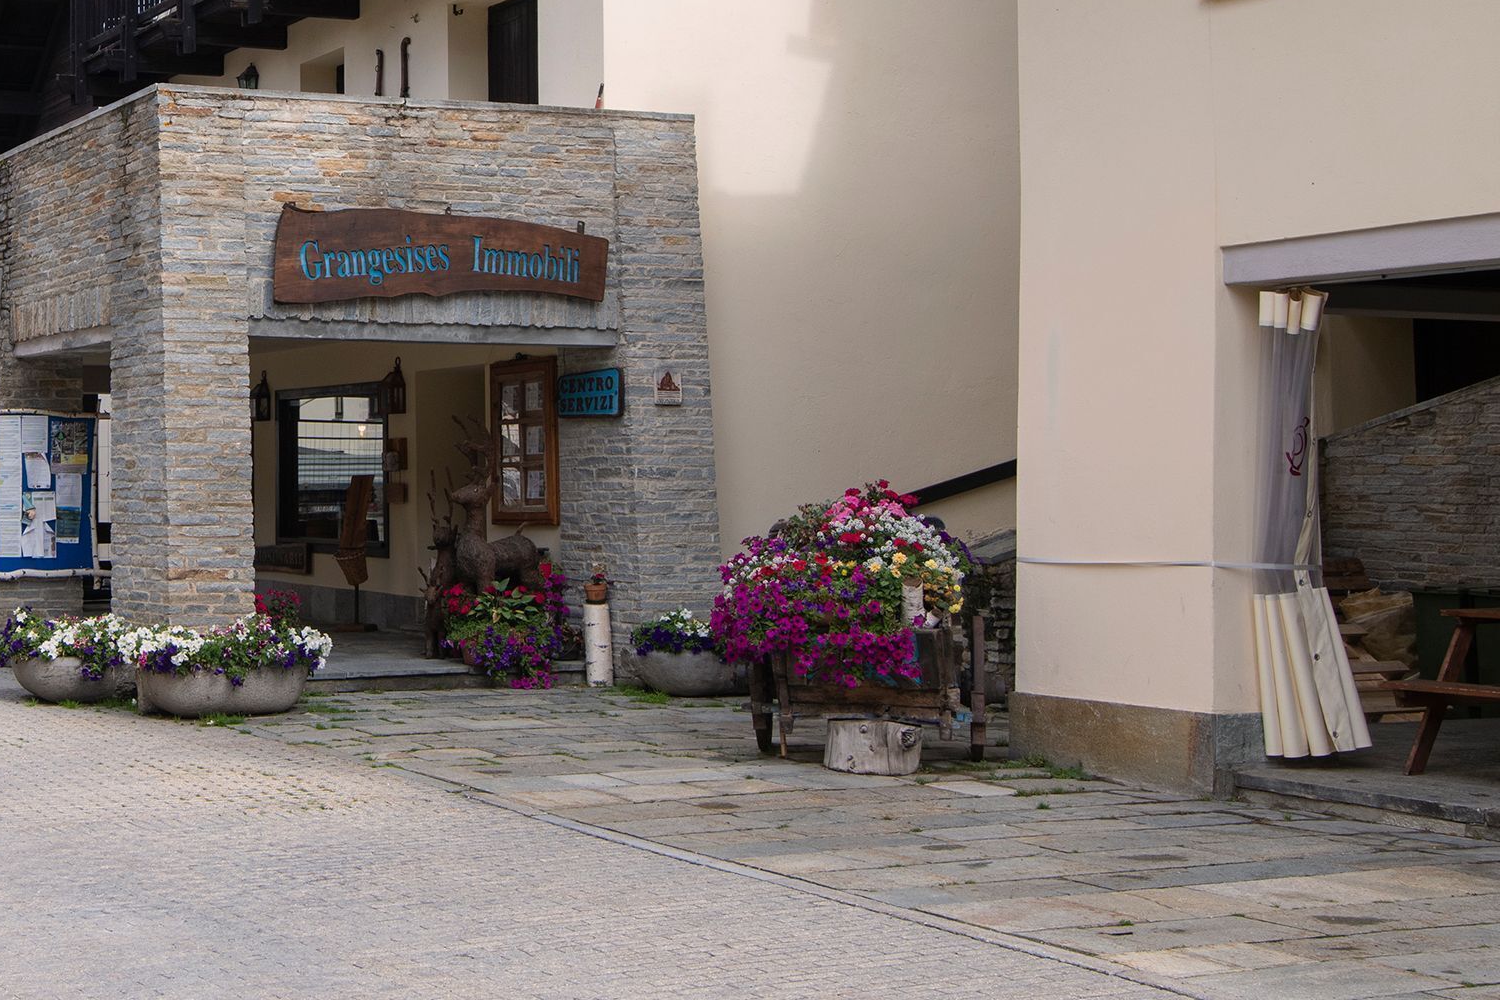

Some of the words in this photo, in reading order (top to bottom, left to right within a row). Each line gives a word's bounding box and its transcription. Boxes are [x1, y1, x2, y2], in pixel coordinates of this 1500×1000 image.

[300, 234, 450, 286] Grangesises
[472, 235, 581, 284] Immobili
[560, 376, 614, 394] CENTRO
[560, 395, 614, 412] SERVIZI
